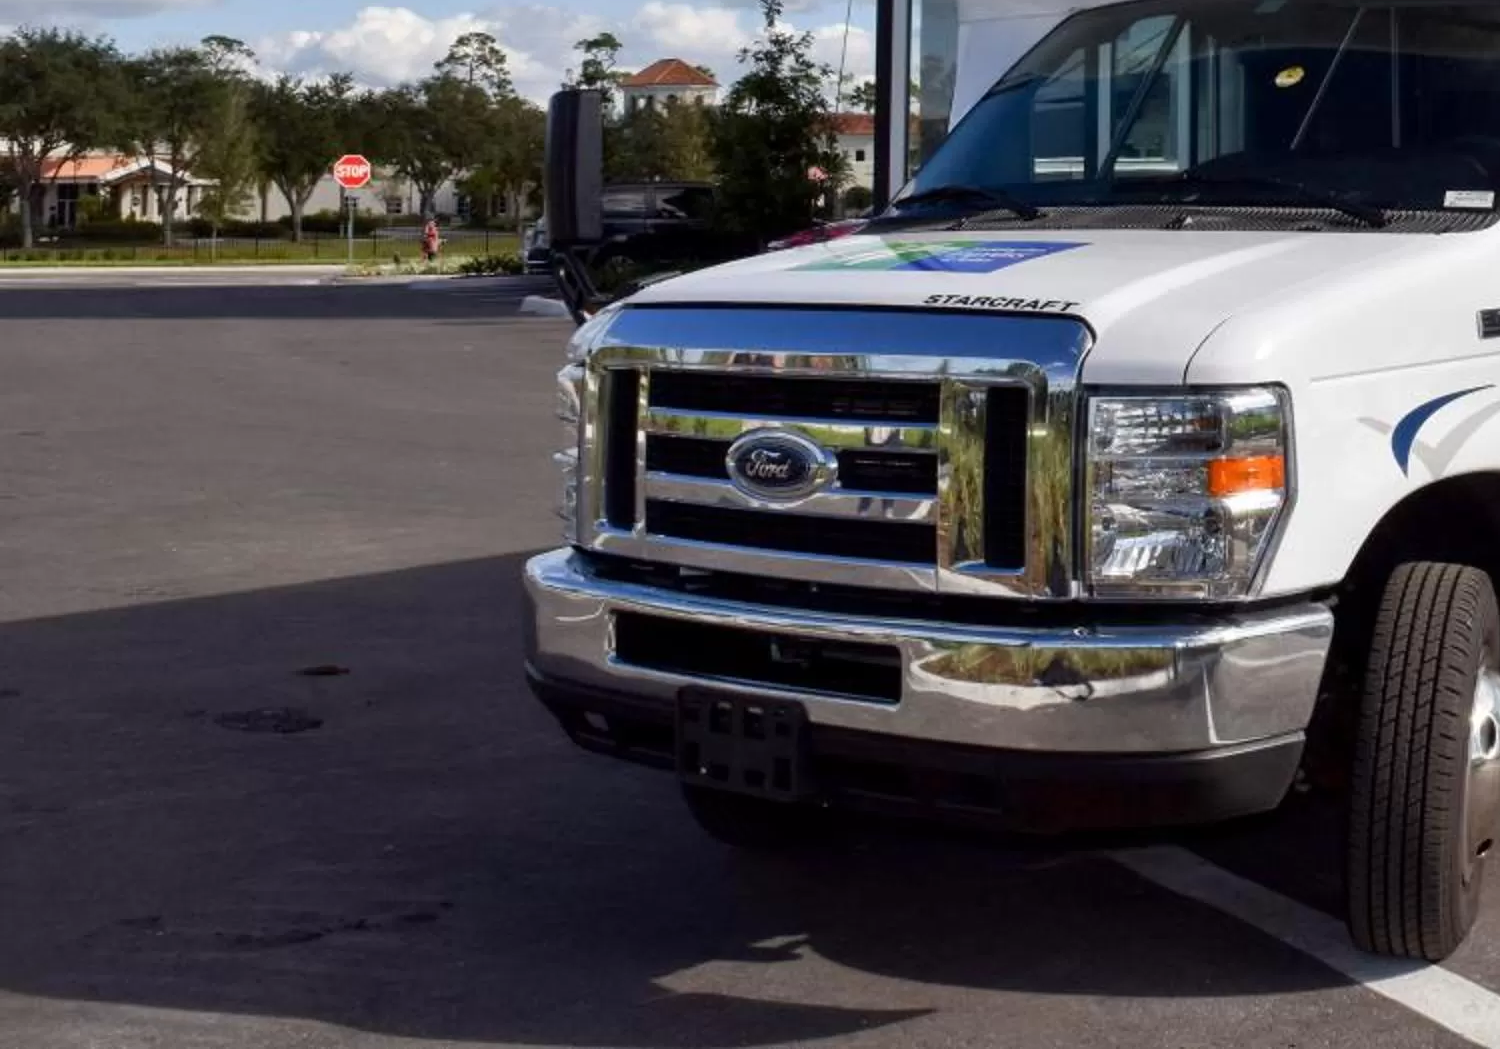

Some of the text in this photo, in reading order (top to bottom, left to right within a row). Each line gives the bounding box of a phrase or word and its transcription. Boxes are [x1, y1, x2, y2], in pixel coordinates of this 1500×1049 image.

[336, 164, 368, 178] STOP
[923, 293, 1081, 313] STARCRAFT
[745, 449, 792, 479] Ford
